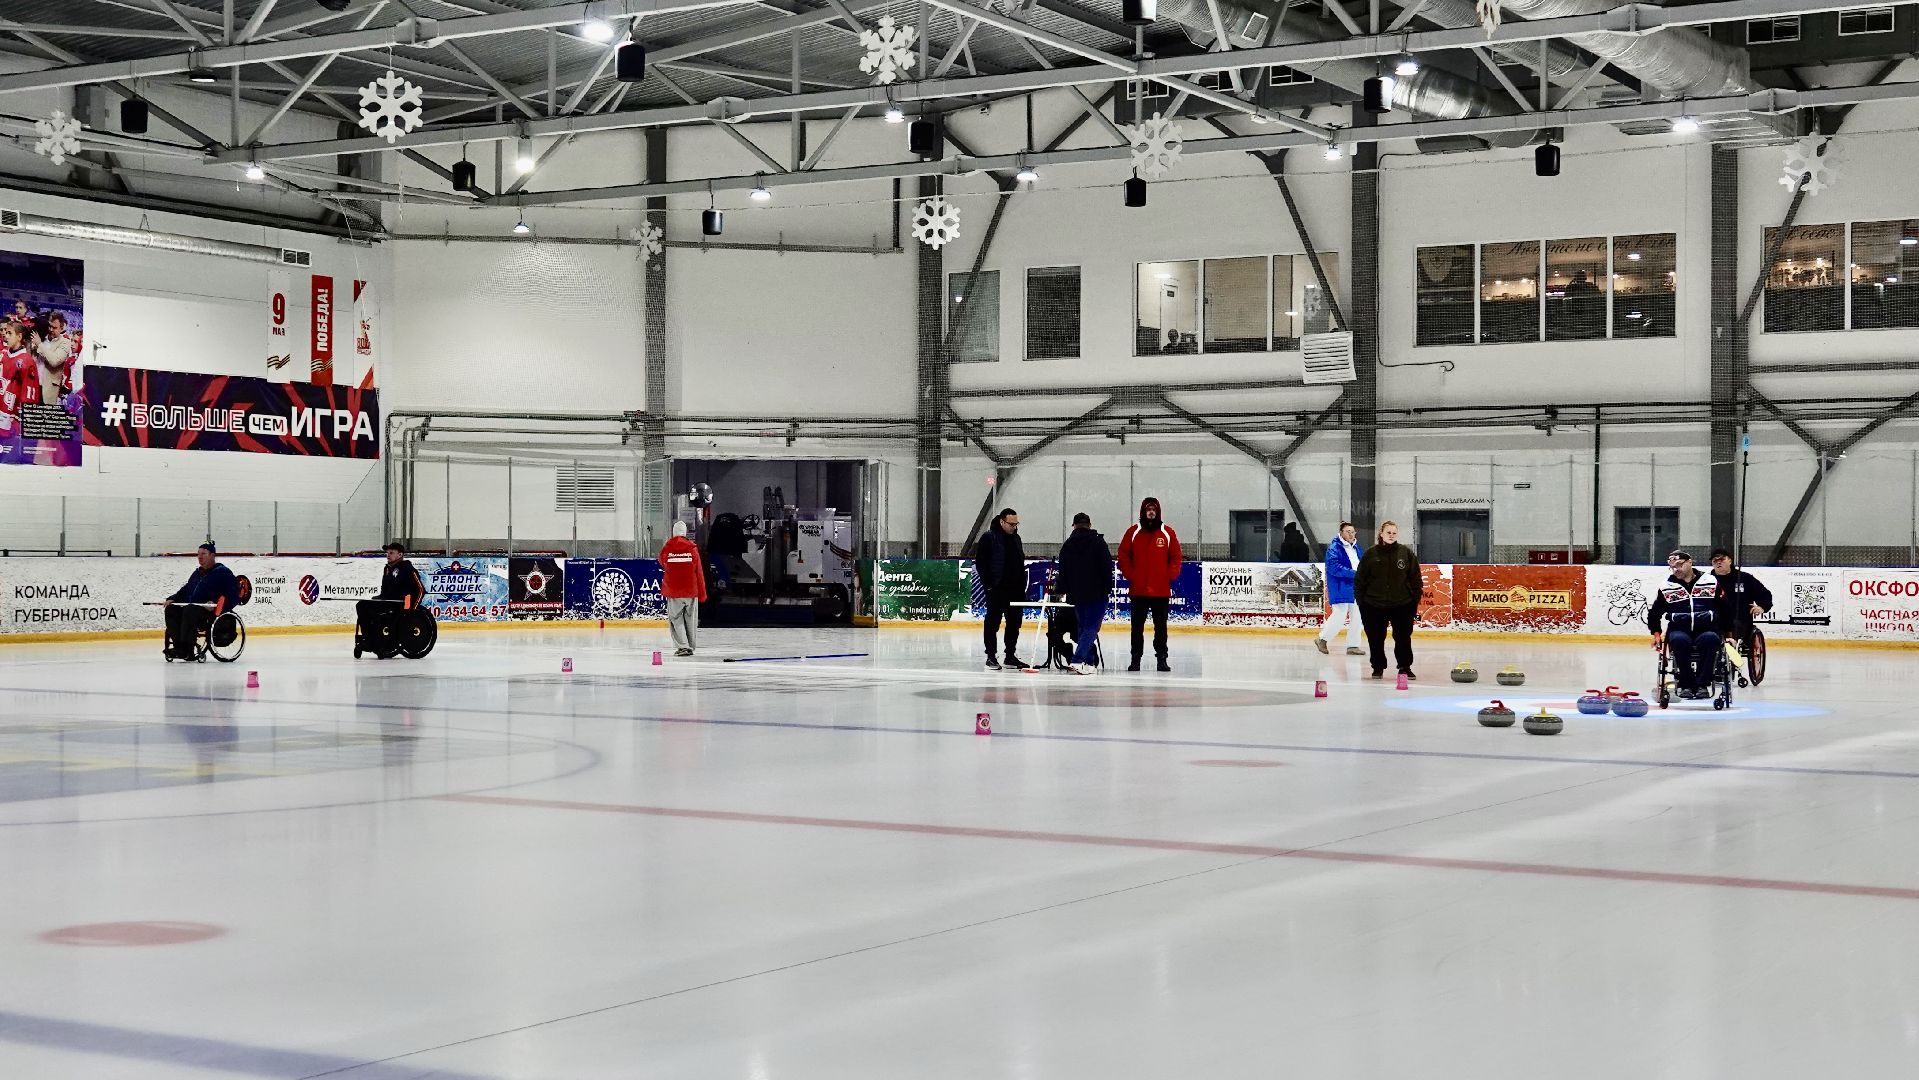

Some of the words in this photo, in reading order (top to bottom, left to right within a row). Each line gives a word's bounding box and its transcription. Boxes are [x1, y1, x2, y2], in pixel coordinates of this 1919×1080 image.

[272, 292, 286, 325] 9
[316, 288, 329, 352] ПОБЕДА!
[272, 327, 286, 336] МАЯ
[252, 417, 285, 432] ЧЕМ
[291, 406, 374, 440] ИГРА
[432, 575, 481, 584] РЕМОНТ
[1210, 575, 1252, 586] КУХНИ
[15, 584, 90, 600] КОМАНДА
[324, 585, 378, 596] Металлургия
[430, 584, 482, 593] КЛЮШЕК
[1210, 587, 1228, 596] ДЛЯ
[1229, 587, 1253, 596] ДАЧИ
[1472, 593, 1508, 604] MARIO
[1529, 594, 1565, 605] PIZZA
[14, 607, 118, 623] ГУБЕРНАТОРА
[1860, 608, 1919, 621] ЧАСТНАЯ
